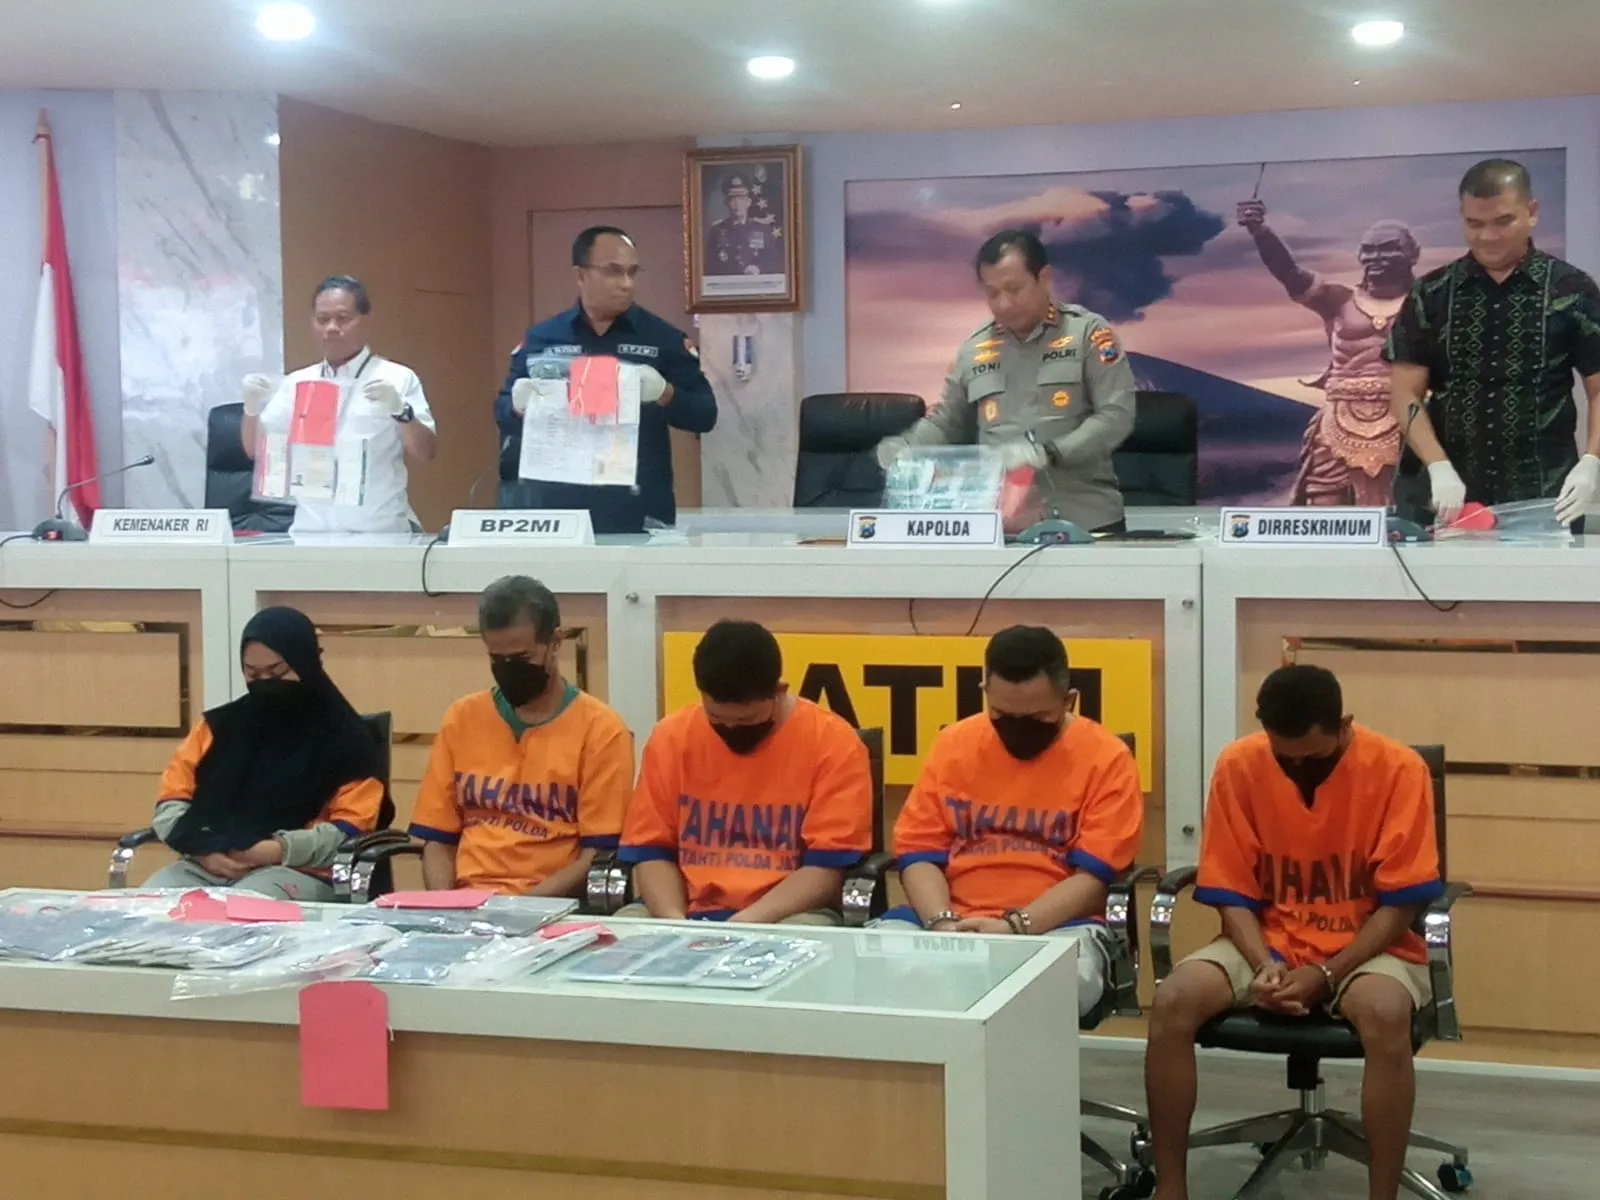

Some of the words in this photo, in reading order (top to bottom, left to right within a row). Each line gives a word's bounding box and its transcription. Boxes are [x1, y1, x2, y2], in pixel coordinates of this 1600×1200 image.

[1041, 348, 1077, 362] POLRI
[971, 361, 1001, 375] TONI
[112, 517, 190, 533] KEMENAKER
[196, 518, 209, 532] RI
[479, 518, 561, 534] BP2MI
[906, 519, 971, 537] KAPOLDA
[1256, 517, 1373, 537] DIRRESKRIMUM
[503, 817, 549, 838] POLDA
